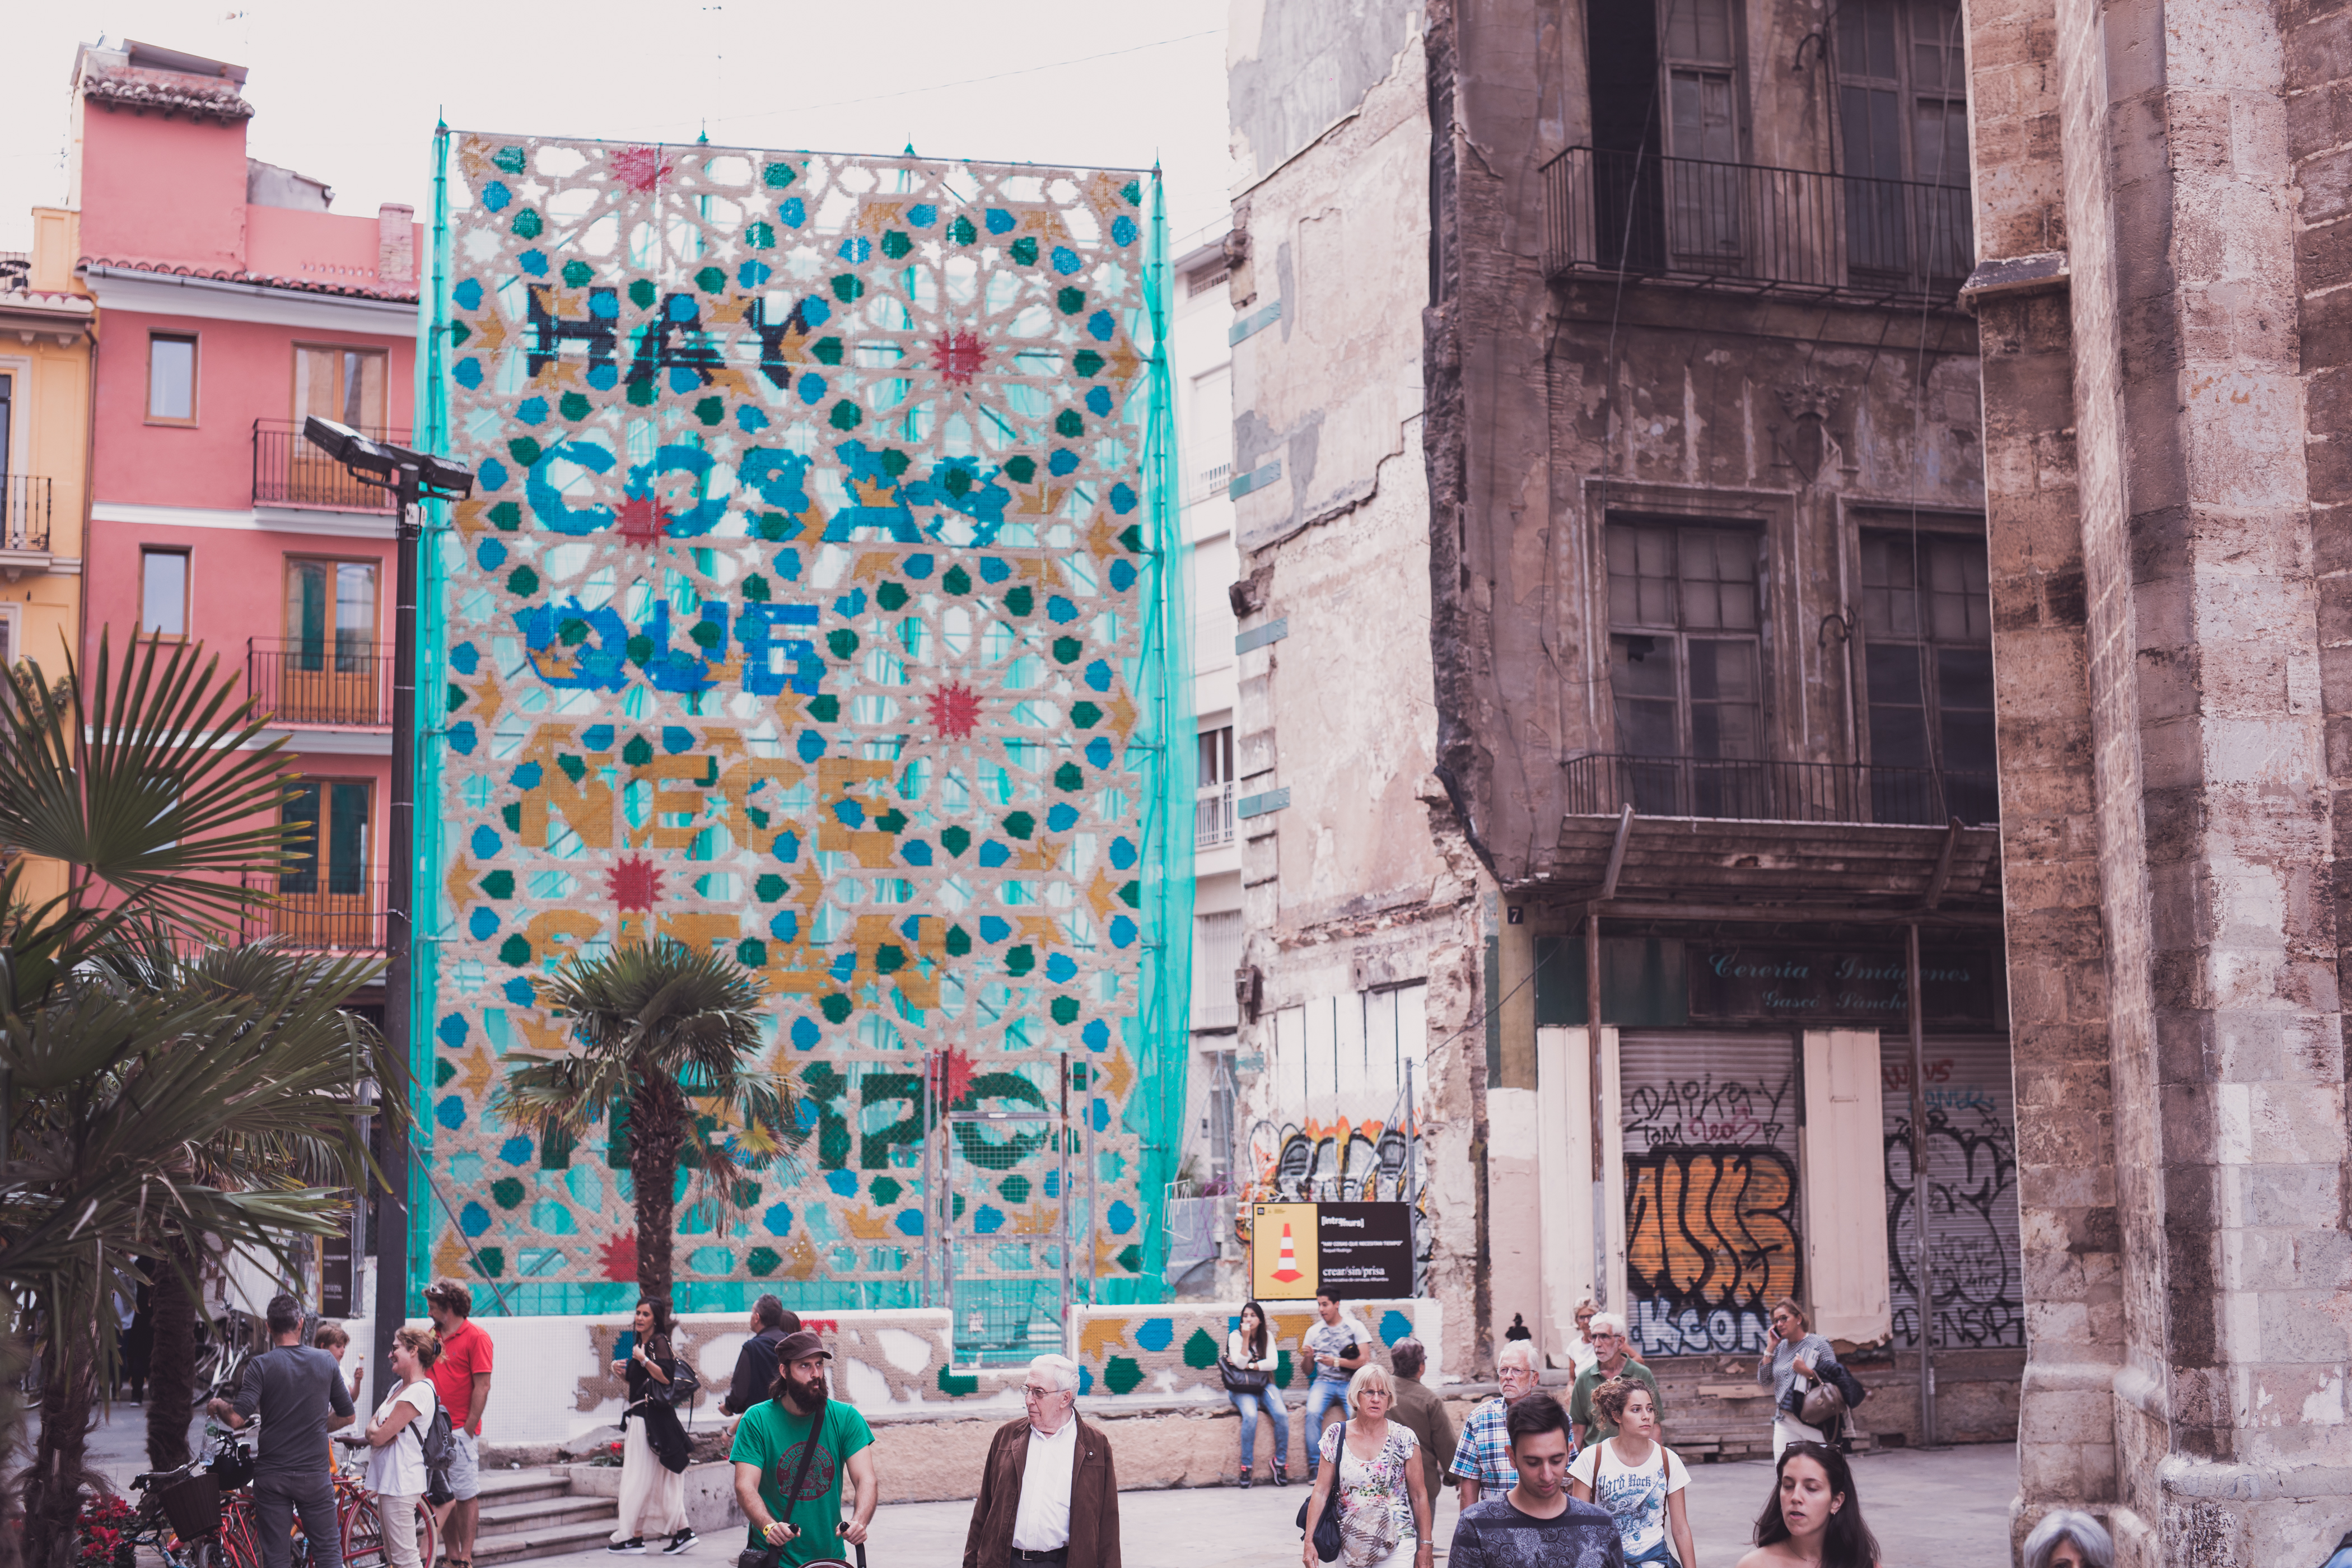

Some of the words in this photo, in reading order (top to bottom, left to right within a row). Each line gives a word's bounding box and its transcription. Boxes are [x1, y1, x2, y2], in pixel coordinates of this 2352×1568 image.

[527, 283, 828, 389] HAY
[526, 439, 1011, 548] COSAS
[526, 598, 820, 696] QUE
[1511, 908, 1519, 923] 7
[1598, 1473, 1625, 1501] Hard
[1628, 1473, 1651, 1487] Rock
